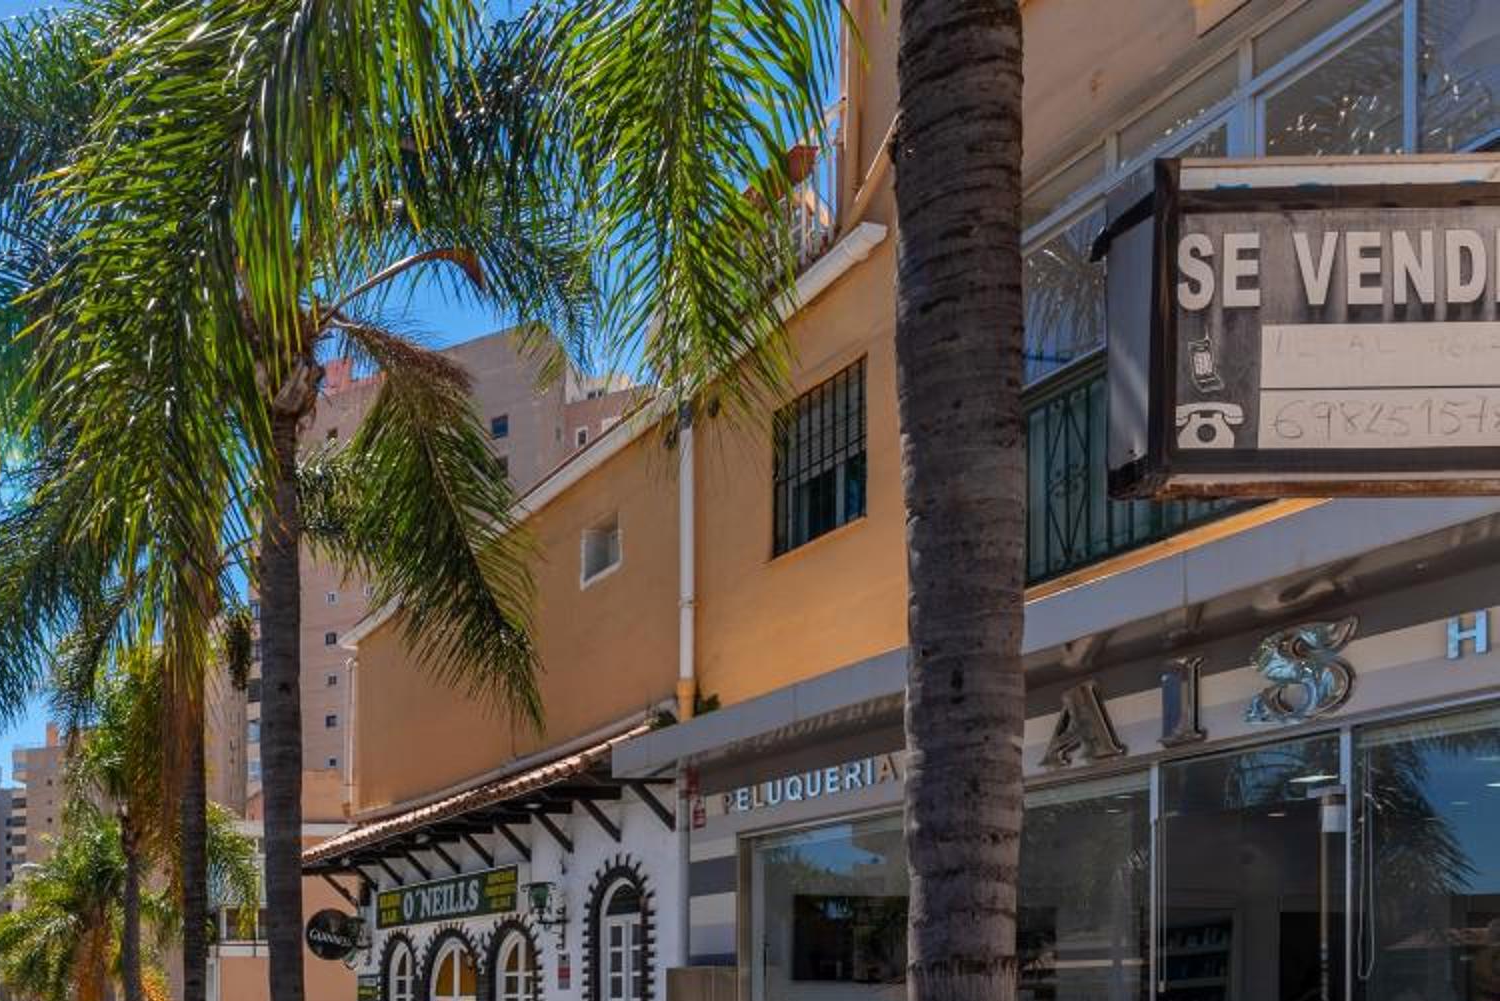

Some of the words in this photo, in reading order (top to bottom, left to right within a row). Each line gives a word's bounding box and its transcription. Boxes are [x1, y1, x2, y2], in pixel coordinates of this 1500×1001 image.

[1177, 232, 1261, 311] SE
[1293, 228, 1500, 306] VEND
[722, 755, 899, 816] PELUQUERIA
